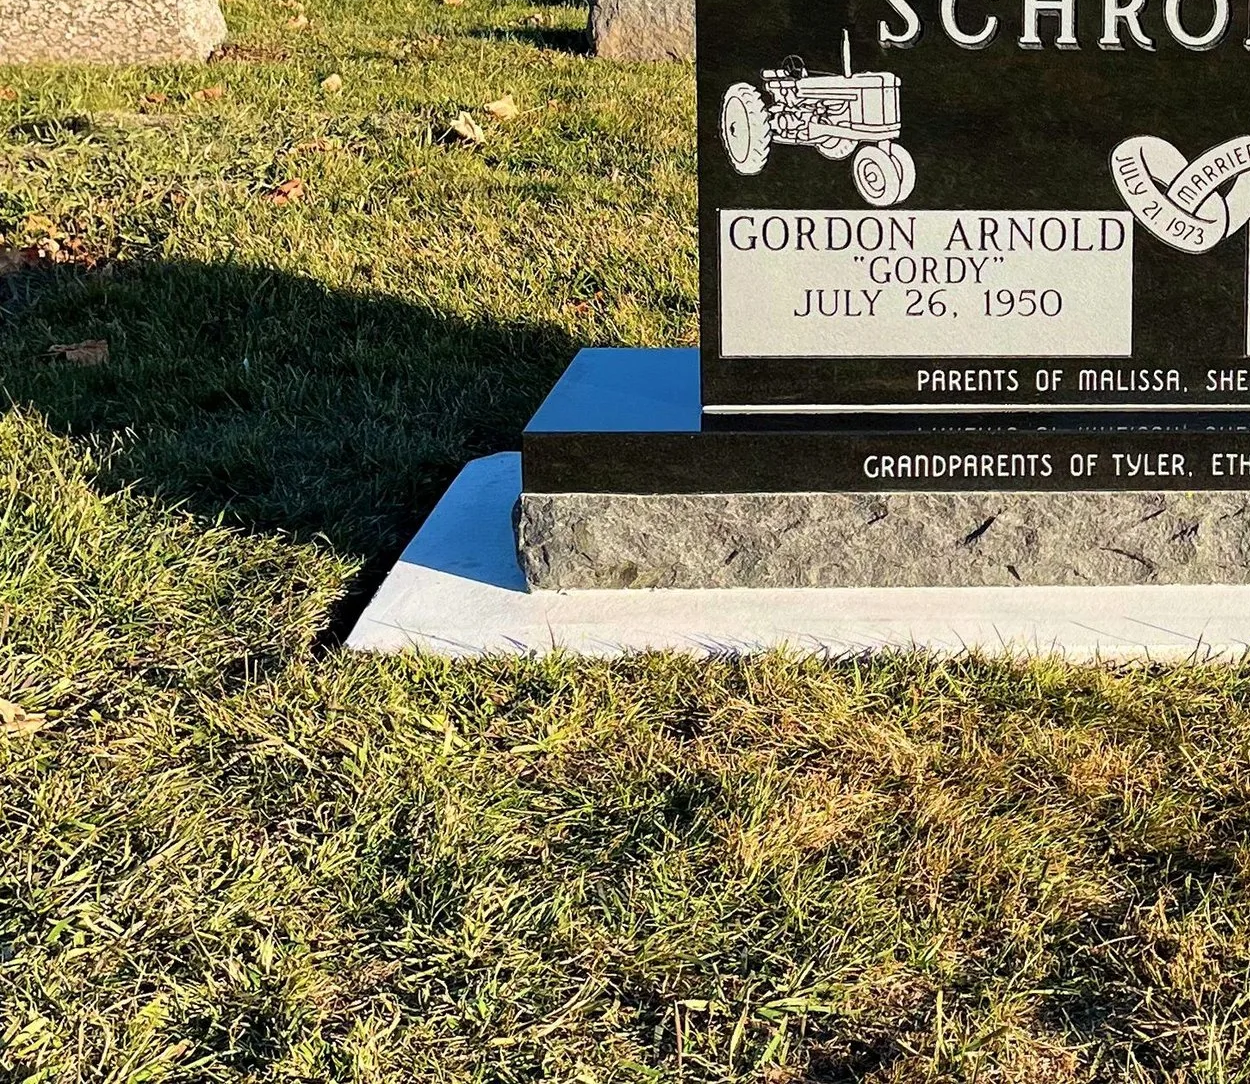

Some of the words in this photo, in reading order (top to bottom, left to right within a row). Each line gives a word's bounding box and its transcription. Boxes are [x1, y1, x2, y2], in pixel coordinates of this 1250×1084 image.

[1116, 156, 1147, 196] JULY
[1166, 217, 1204, 245] 1973
[729, 216, 916, 252] GORDON
[945, 217, 1126, 252] ARNOLD
[793, 289, 881, 318] JULY
[905, 289, 958, 319] 26,
[984, 289, 1063, 317] 1950
[917, 369, 1019, 392] PARENTS
[1036, 369, 1063, 392] OF
[863, 454, 1053, 479] GRANDPARENTS
[1070, 453, 1098, 477] OF
[1112, 453, 1193, 478] TYLER,
